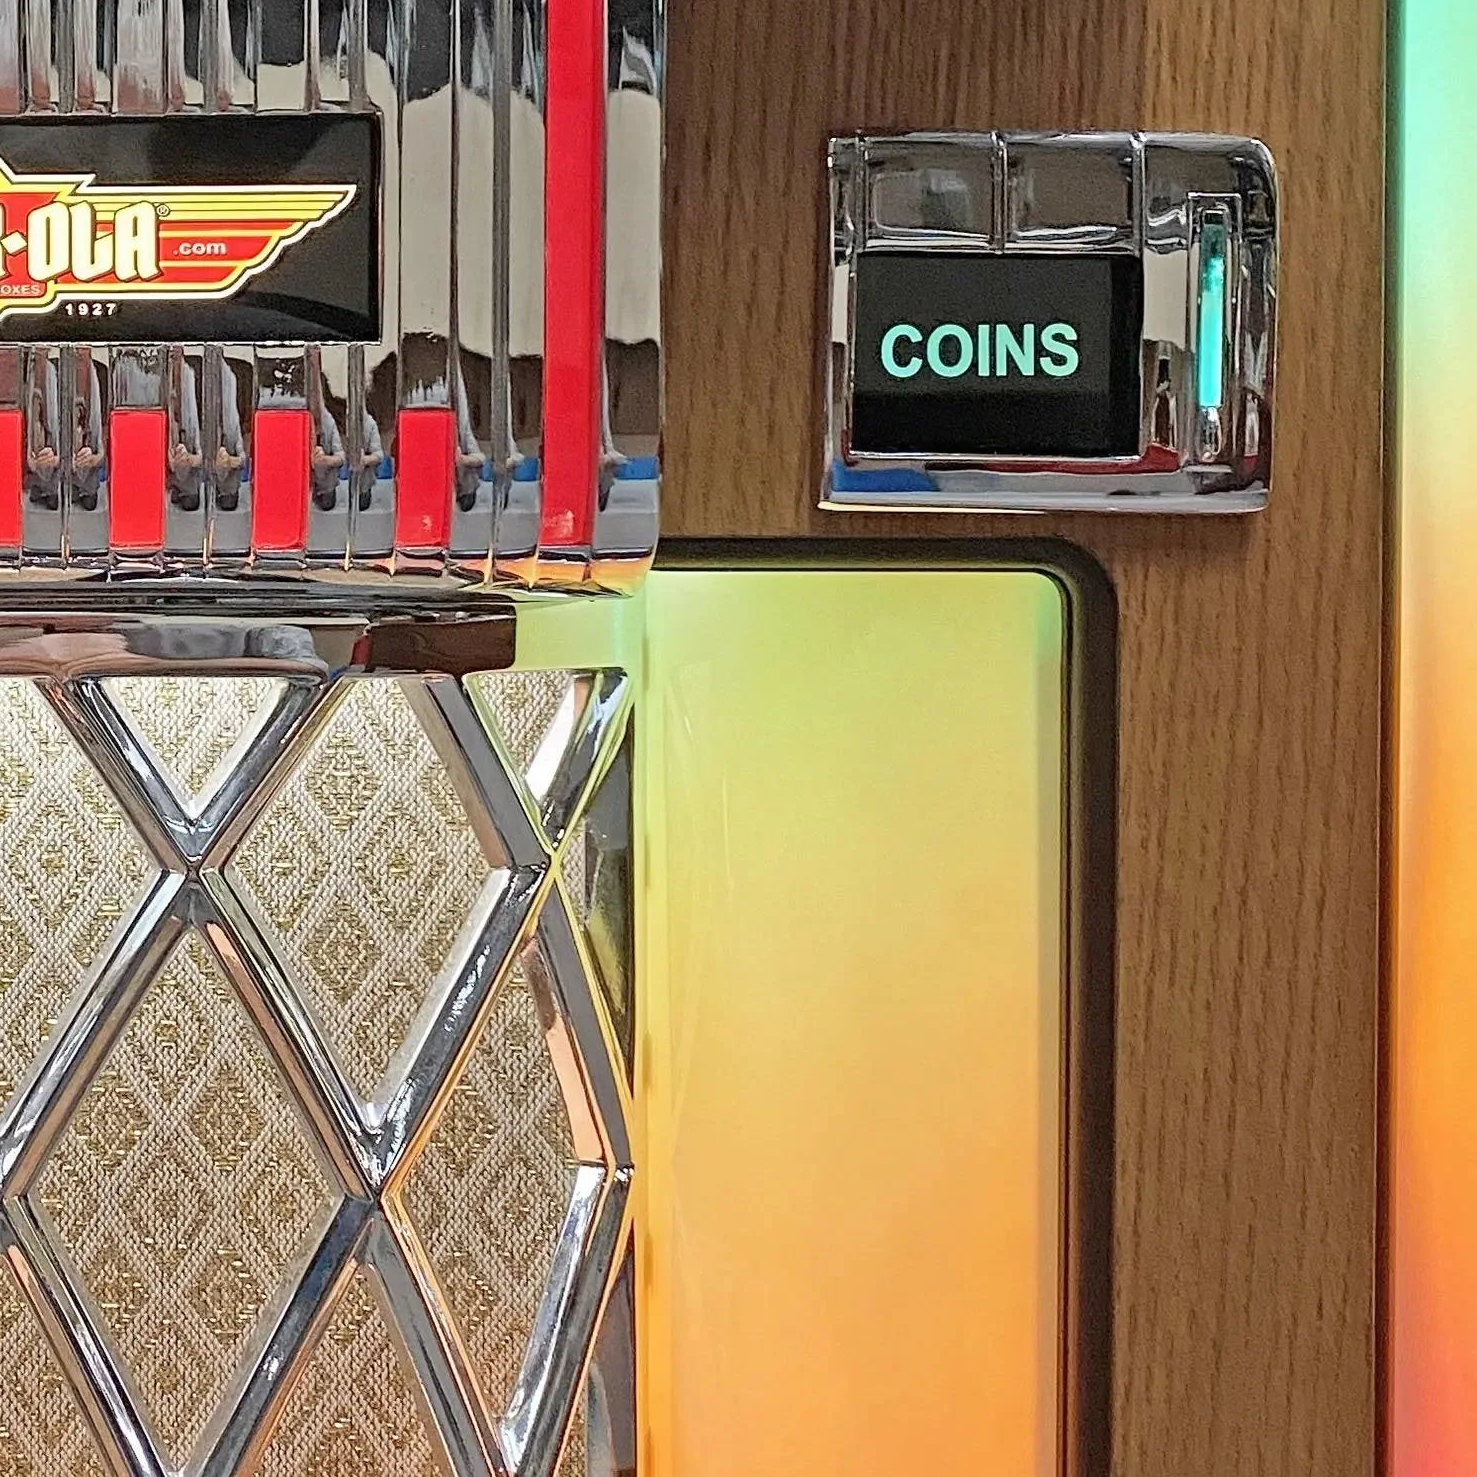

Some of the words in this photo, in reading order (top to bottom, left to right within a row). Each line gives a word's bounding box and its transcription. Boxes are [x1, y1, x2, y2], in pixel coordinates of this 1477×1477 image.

[173, 242, 227, 256] .com
[65, 303, 118, 316] 1927
[880, 323, 1080, 378] COINS
